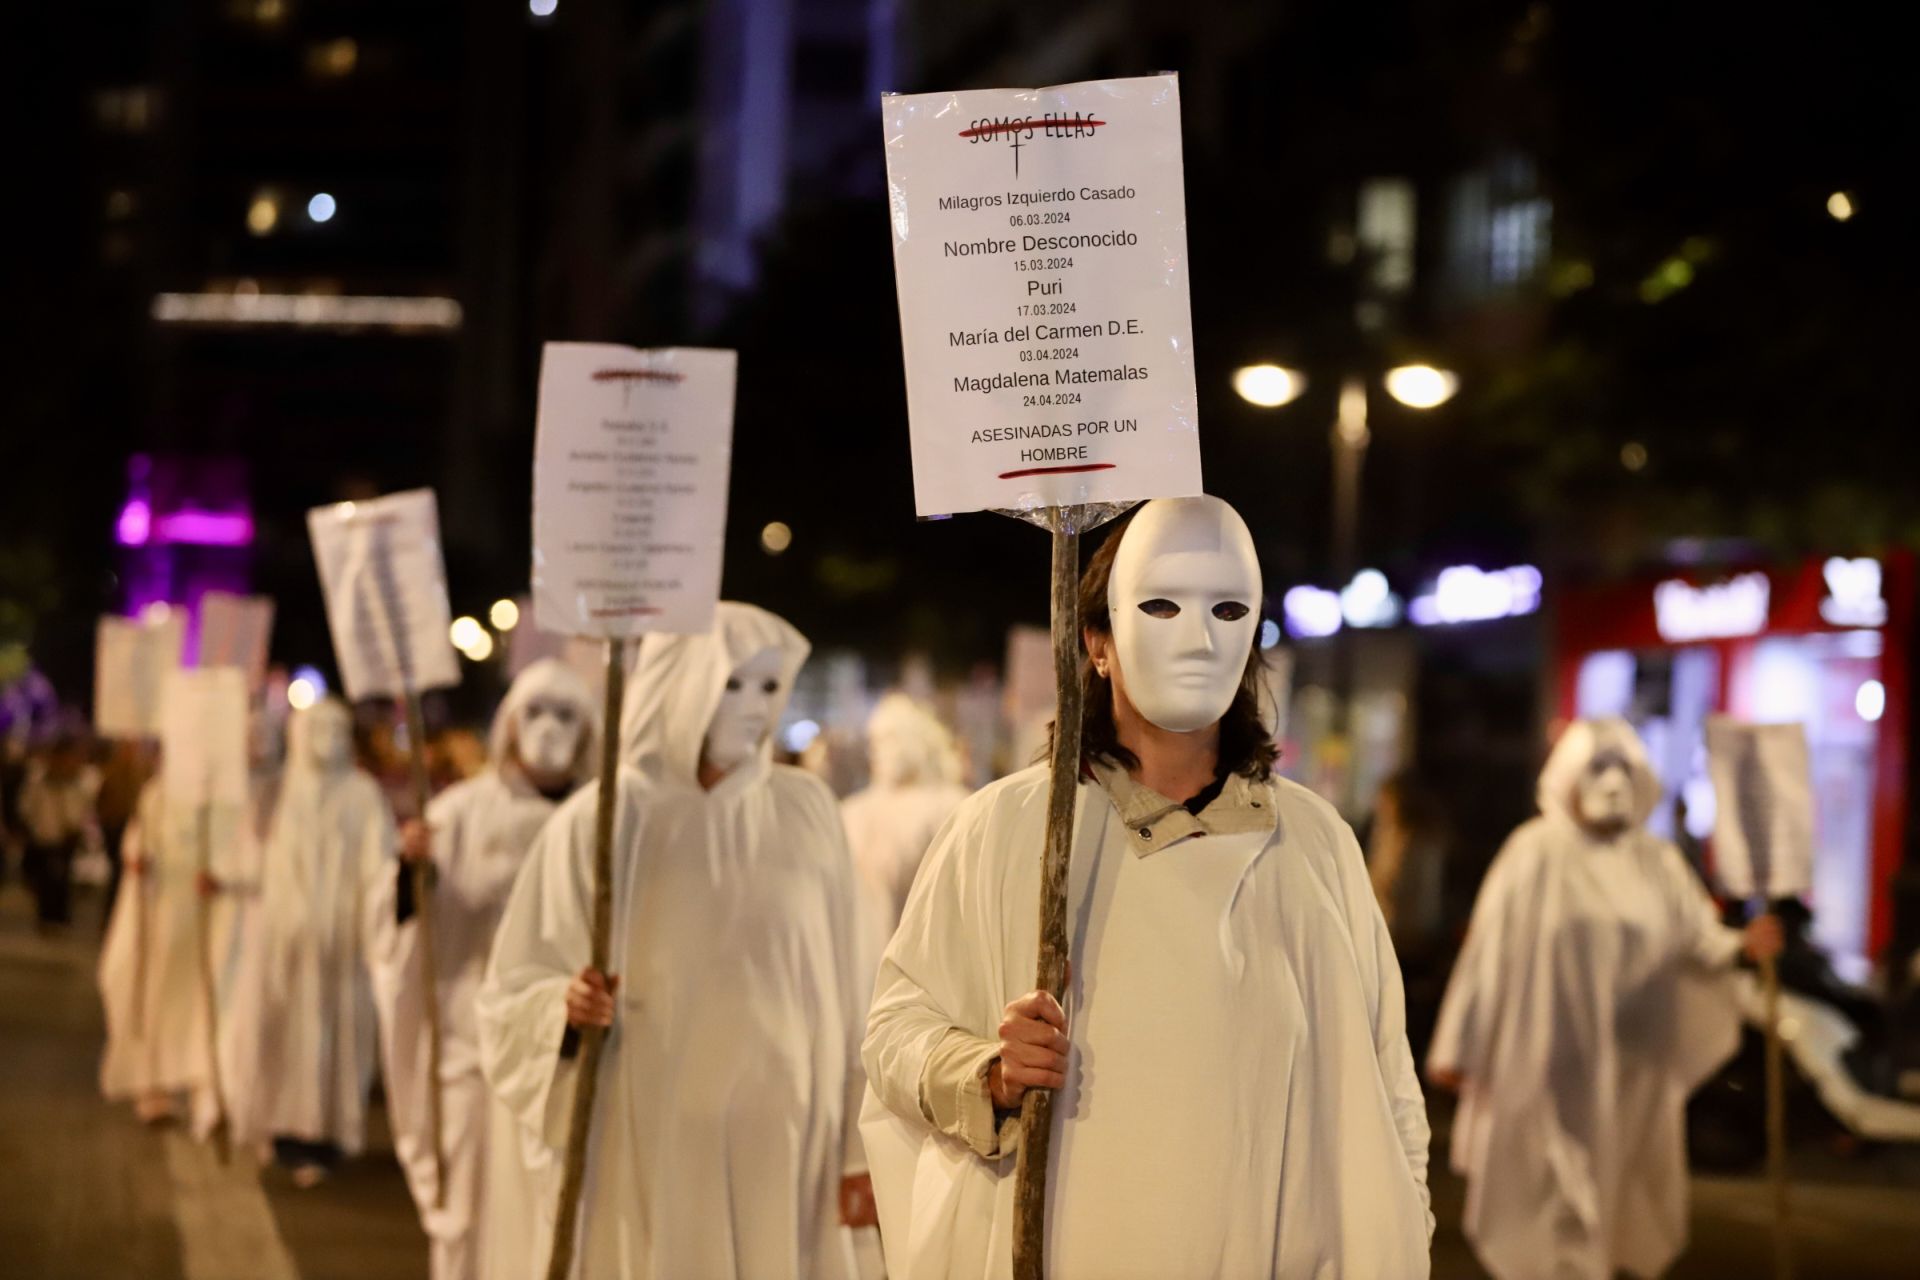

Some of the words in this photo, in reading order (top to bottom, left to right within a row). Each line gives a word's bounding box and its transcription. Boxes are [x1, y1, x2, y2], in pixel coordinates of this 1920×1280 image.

[969, 115, 1034, 144] SOMOS
[1044, 112, 1096, 138] ELLAS
[938, 194, 1002, 211] Milagros
[1007, 188, 1075, 207] Izquierdo
[1080, 185, 1135, 201] Casado
[1010, 212, 1070, 227] 06.03.2024
[944, 238, 1016, 257] Nombre
[1023, 230, 1137, 251] Desconocido
[1014, 258, 1073, 271] 15.03.2024
[1028, 278, 1062, 296] Puri
[1017, 303, 1076, 316] 17.03.2024
[950, 328, 999, 347] María
[1004, 324, 1030, 343] del
[1035, 323, 1103, 341] Carmen
[1107, 319, 1144, 336] D.E.
[1020, 348, 1078, 362] 03.04.2024
[954, 372, 1050, 394] Magdalena
[1056, 365, 1148, 384] Matemalas
[1024, 393, 1081, 406] 24.04.2024
[972, 424, 1072, 443] ASESINADAS
[1078, 421, 1108, 435] POR
[1114, 419, 1137, 432] UN
[1021, 446, 1087, 462] HOMBRE
